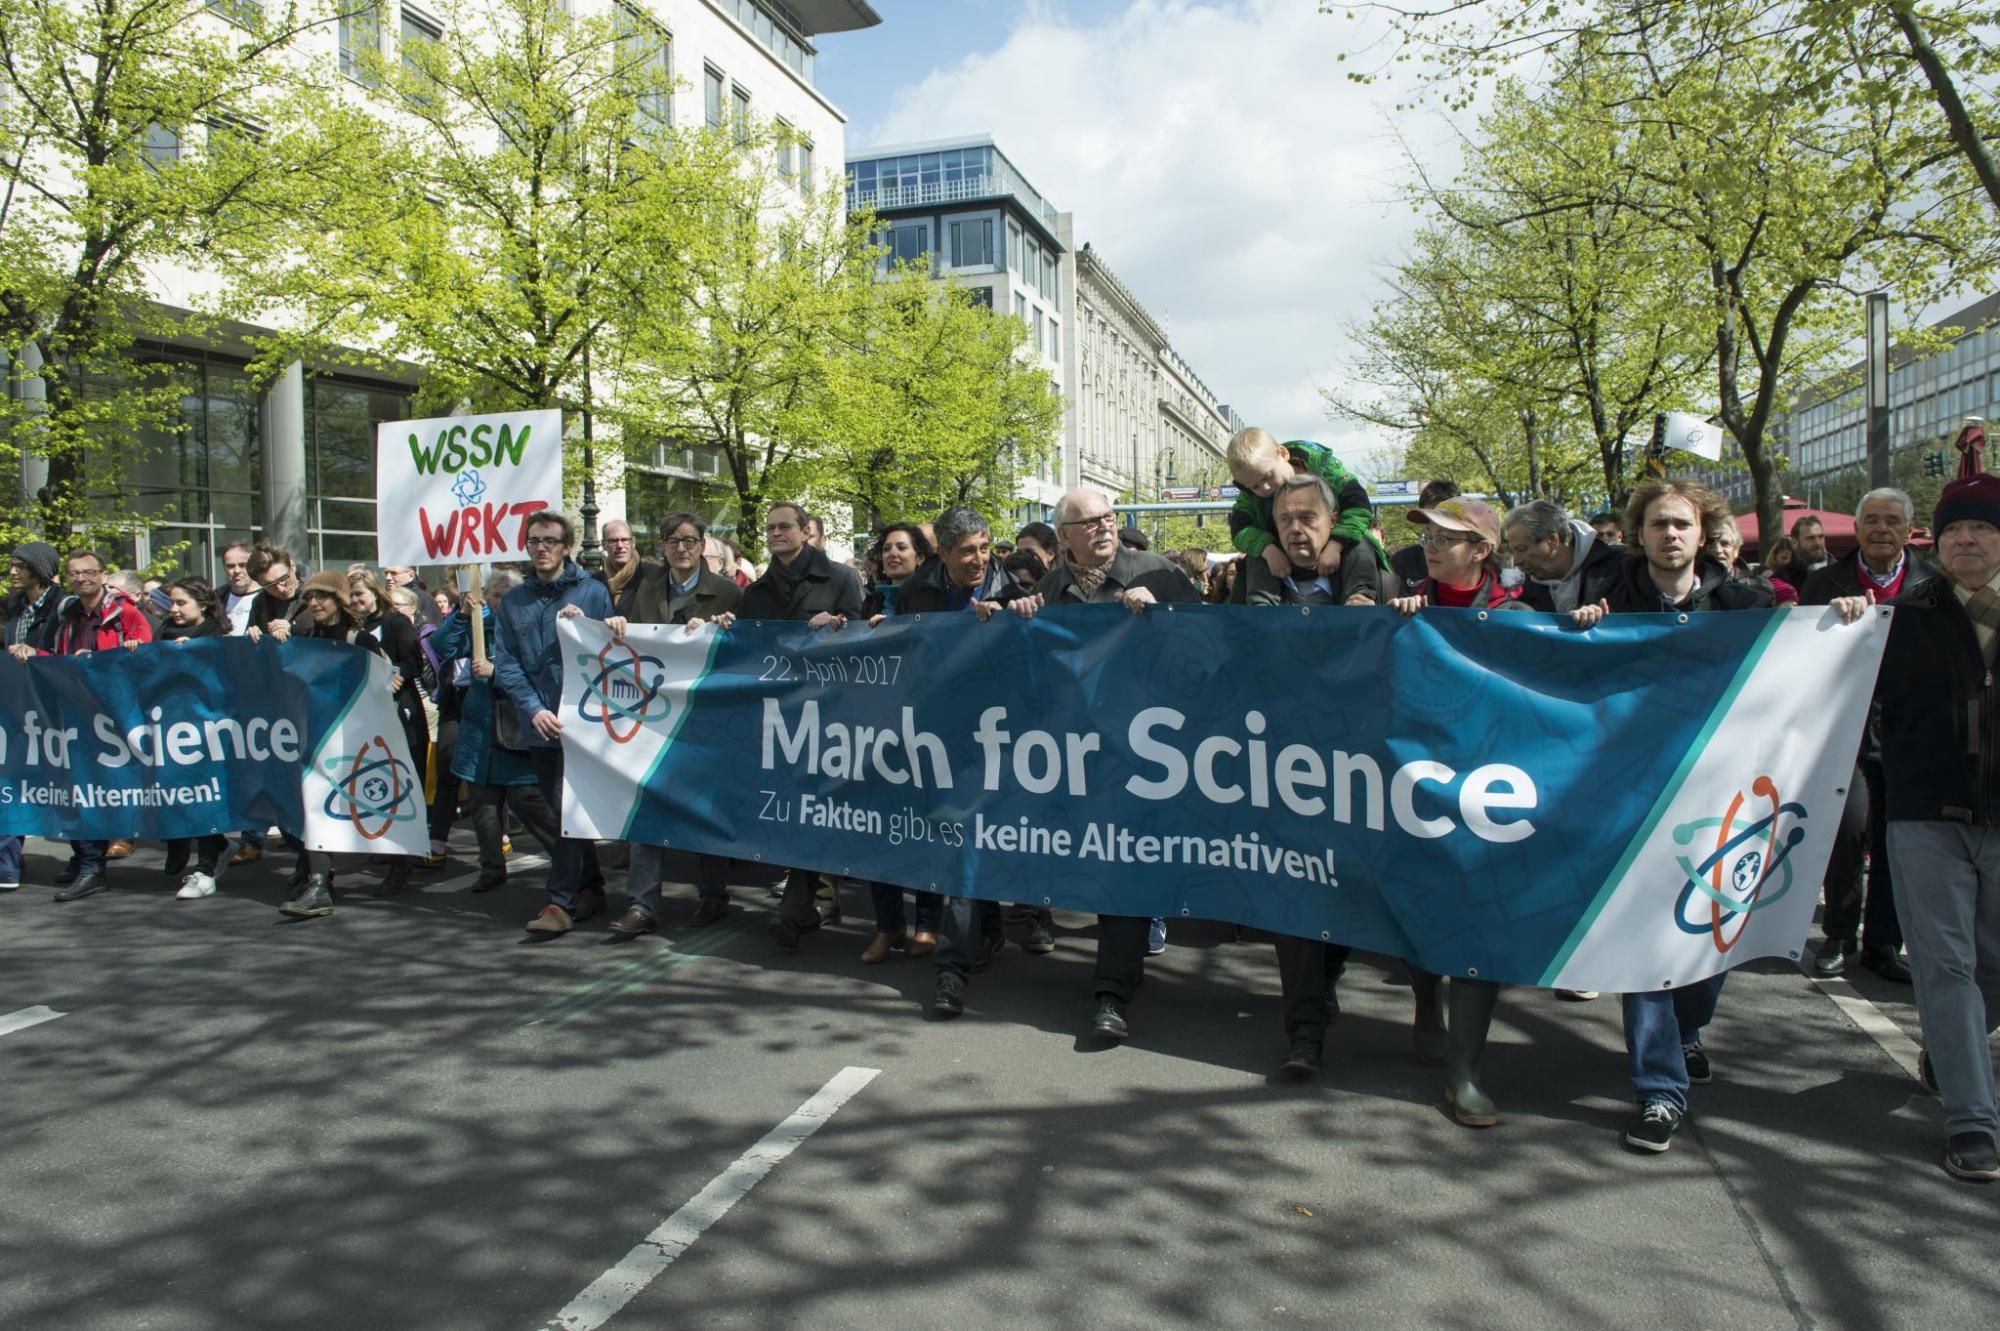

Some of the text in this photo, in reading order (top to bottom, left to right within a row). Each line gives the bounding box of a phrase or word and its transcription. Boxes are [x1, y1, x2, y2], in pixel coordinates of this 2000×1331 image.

[408, 423, 532, 475] WSSN
[419, 500, 549, 559] WRKT
[758, 655, 902, 688] 22. April 2017
[23, 710, 78, 769] for
[93, 705, 300, 768] Science
[1, 776, 222, 809] s keine Alternativen!
[761, 696, 1538, 844] March for Science
[758, 790, 790, 822] Zu
[800, 793, 882, 835] Fakten
[940, 821, 964, 848] es
[975, 812, 1072, 857] keine
[1078, 822, 1339, 888] Alternativen!
